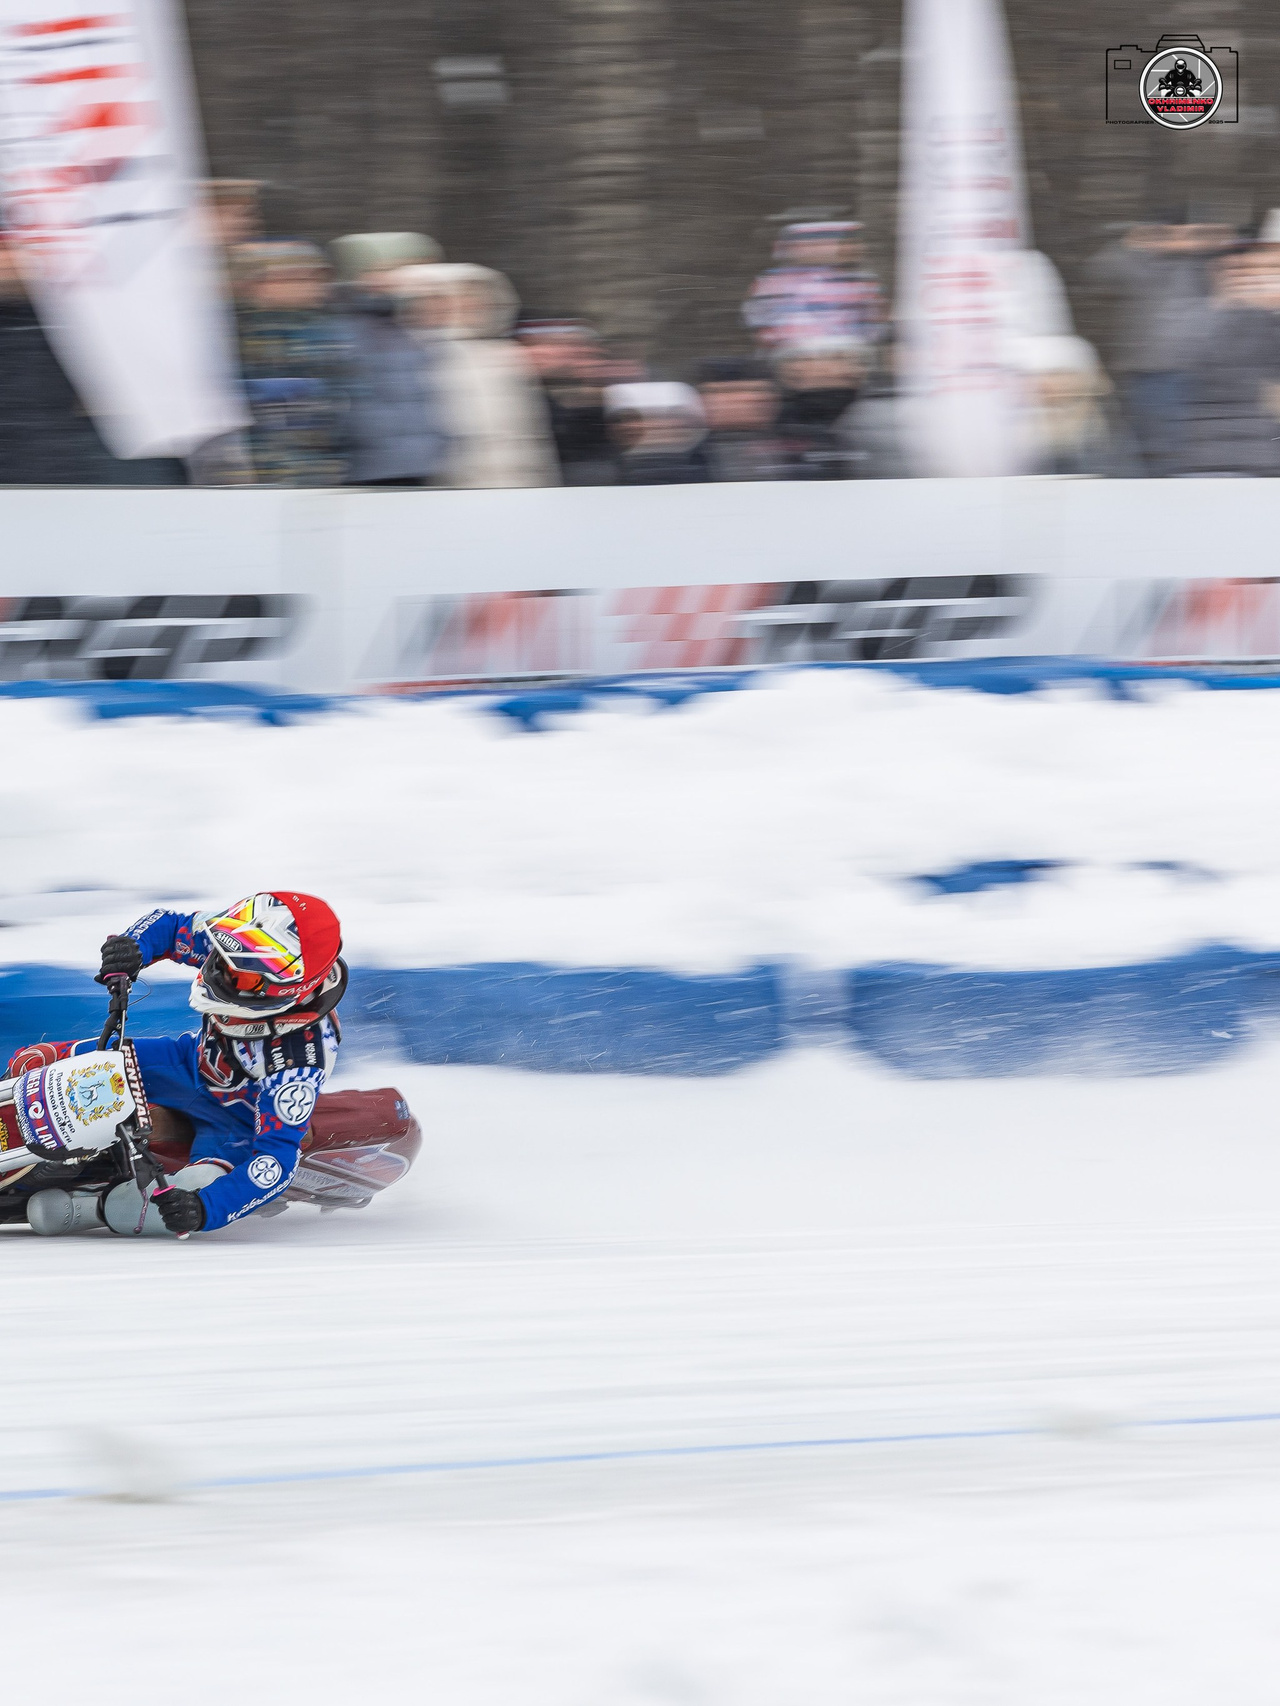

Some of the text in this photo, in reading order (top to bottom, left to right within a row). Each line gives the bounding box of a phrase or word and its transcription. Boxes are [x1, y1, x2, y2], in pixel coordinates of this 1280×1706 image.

[216, 931, 240, 952] SHOEI
[25, 1069, 43, 1097] MEGA
[46, 1068, 73, 1143] Самарской области
[55, 1071, 77, 1134] Правительство
[121, 1045, 149, 1128] RENTHAL
